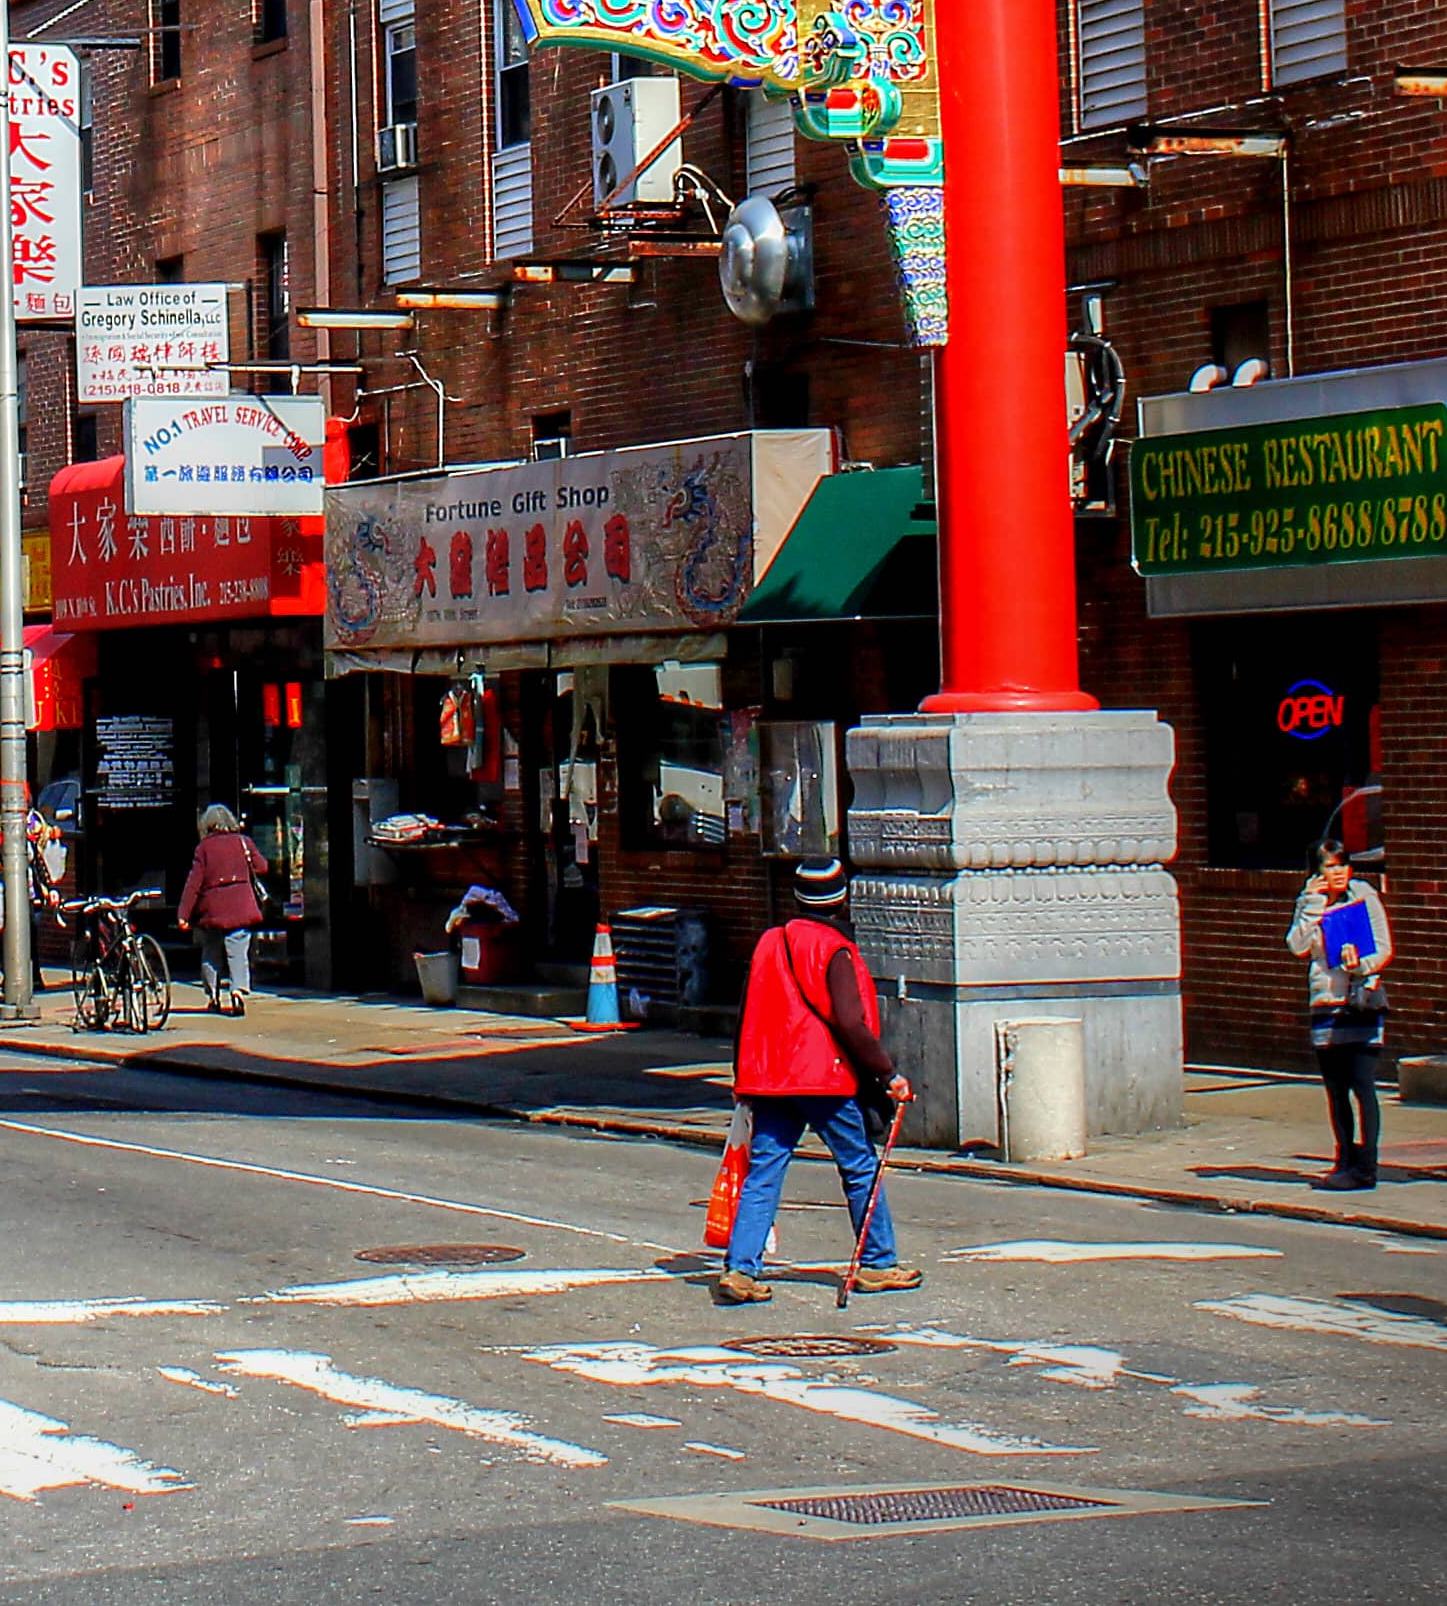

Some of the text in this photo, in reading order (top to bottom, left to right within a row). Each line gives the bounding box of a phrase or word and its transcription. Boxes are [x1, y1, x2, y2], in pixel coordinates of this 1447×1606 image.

[106, 290, 196, 307] Law Office of
[81, 310, 136, 331] Gregory
[205, 313, 221, 325] LLC
[83, 381, 180, 396] (215)418-0818
[143, 419, 183, 456] NO.1
[182, 405, 228, 430] TRAVEL
[235, 406, 283, 437] SERVICE
[1141, 418, 1444, 500] CHINESE RESTAURANT
[425, 485, 610, 523] Fortune Gift Shop
[1145, 492, 1447, 563] Tel: 215-925-8688/8788
[1277, 695, 1345, 732] OPEN
